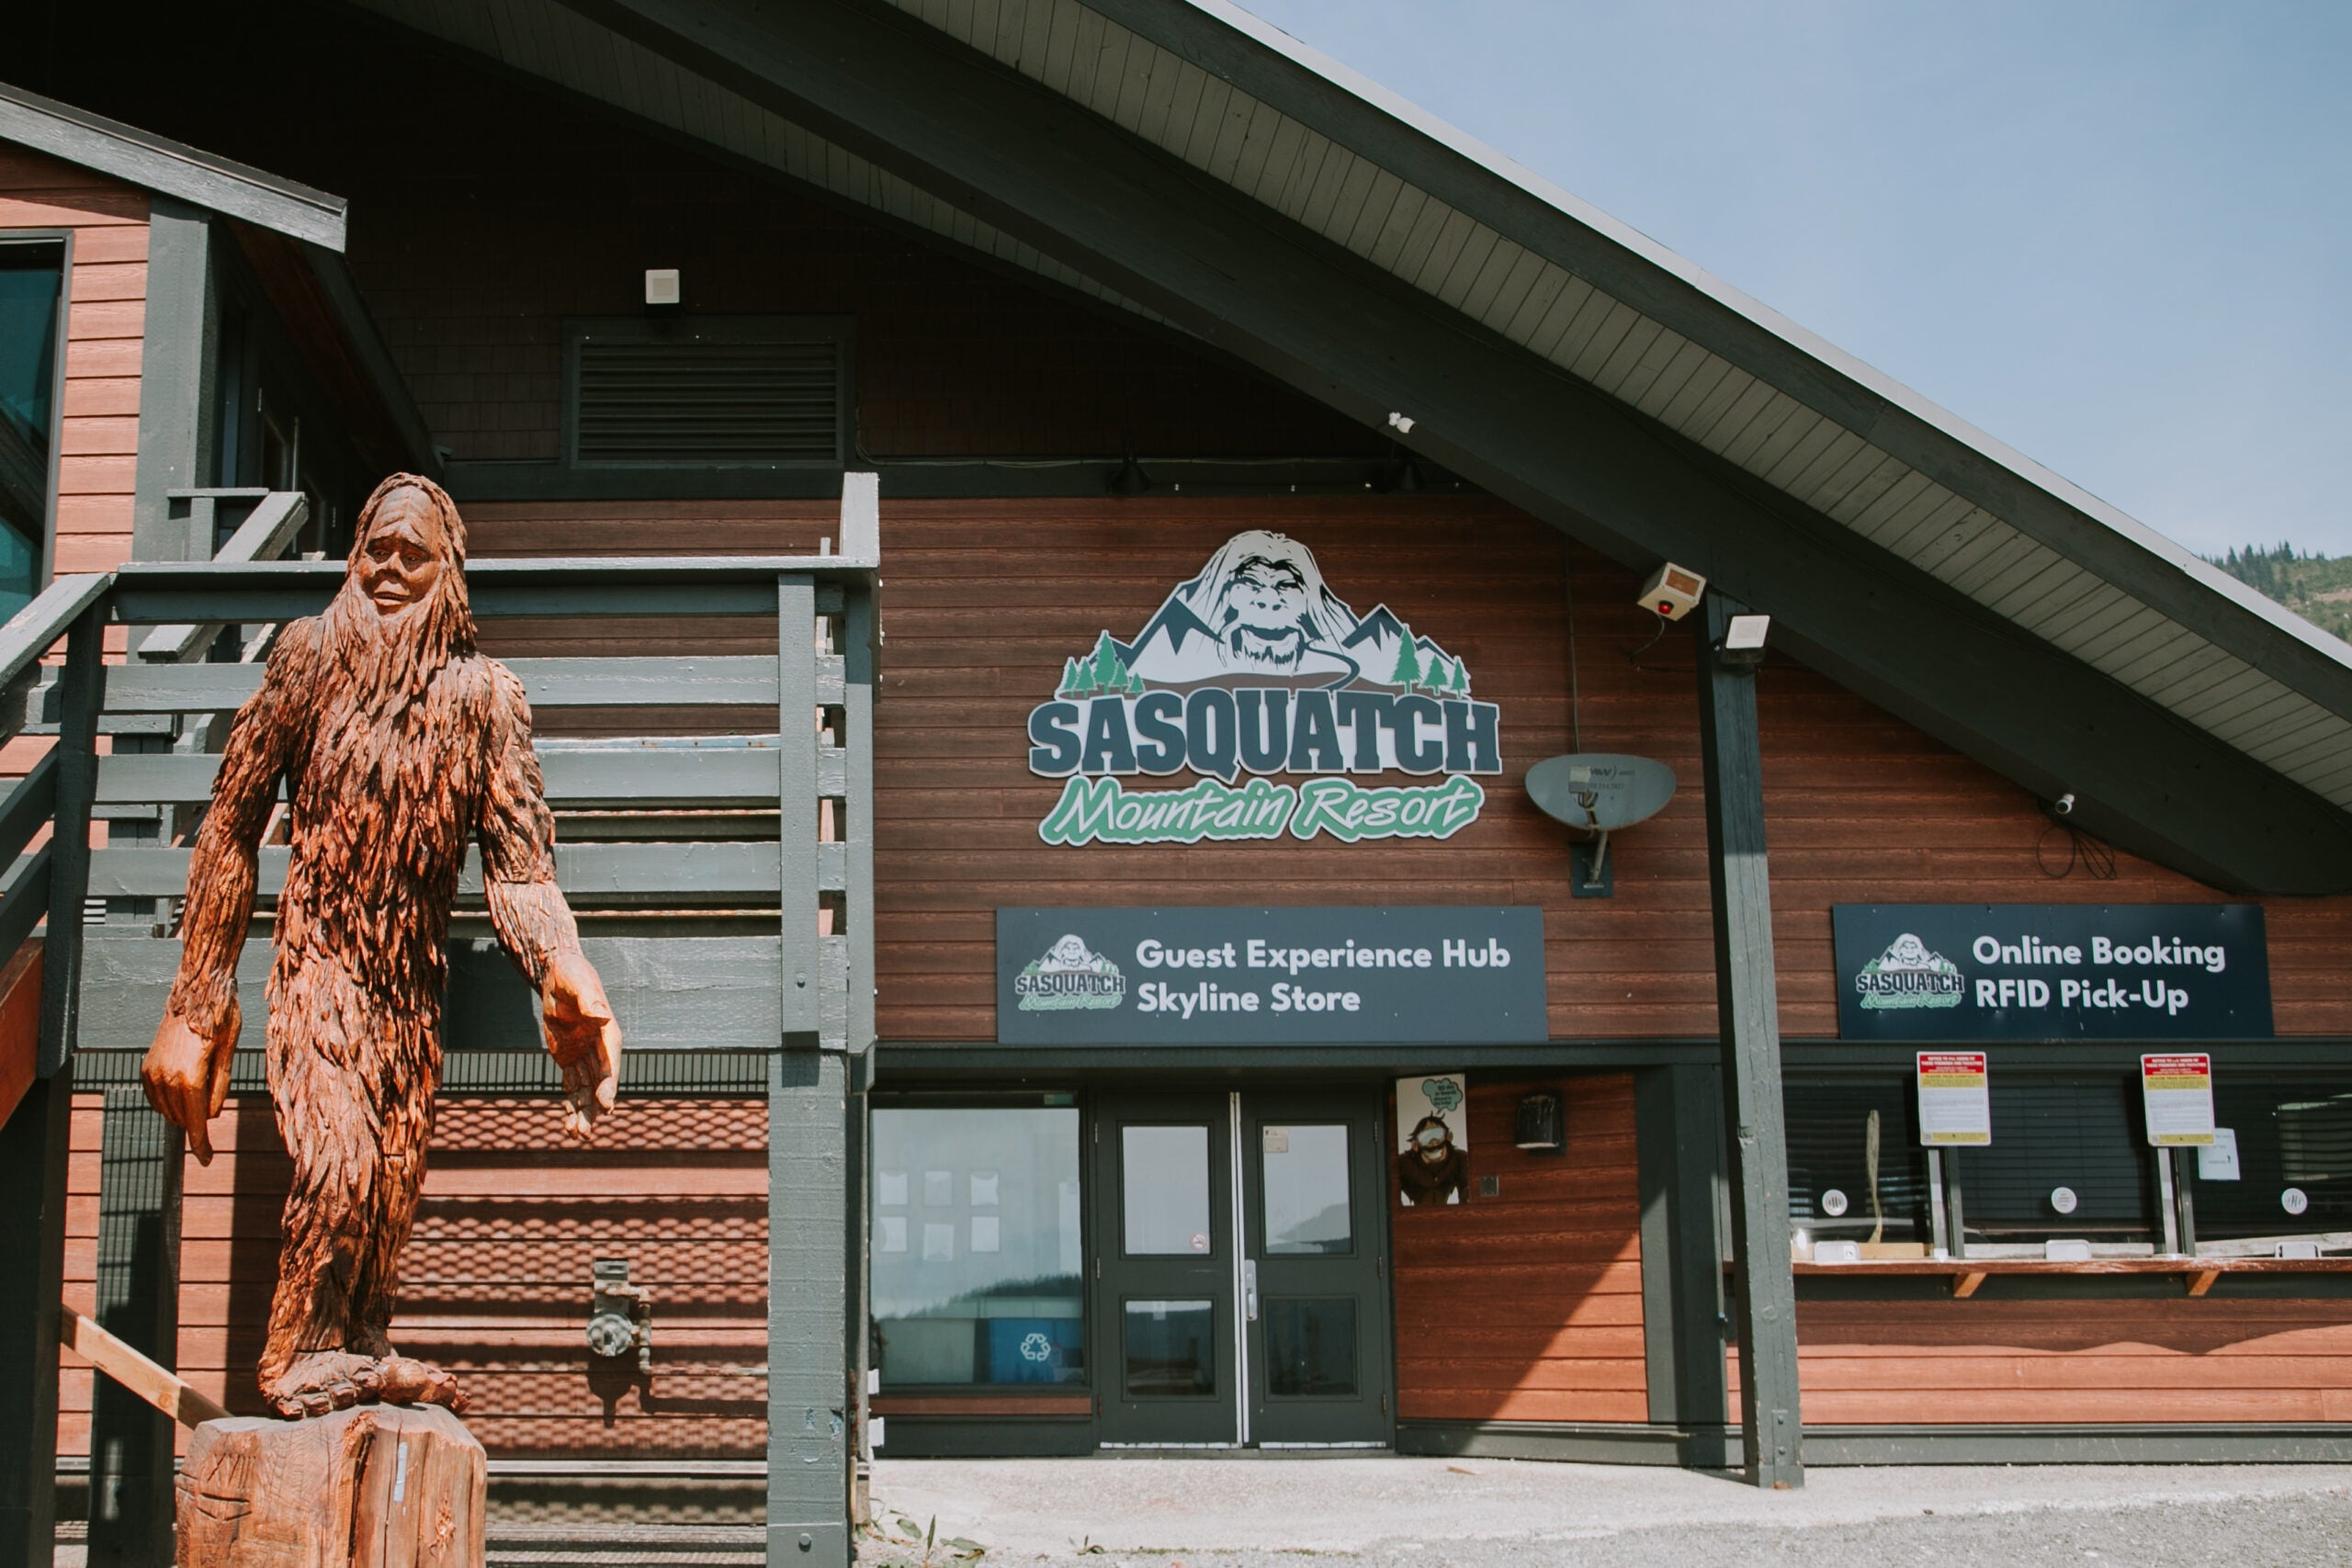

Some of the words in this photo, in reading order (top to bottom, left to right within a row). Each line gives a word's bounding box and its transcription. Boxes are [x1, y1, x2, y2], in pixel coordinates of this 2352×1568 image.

[1029, 687, 1502, 784] SASQUATCH
[1052, 784, 1288, 835] Mountain
[1302, 784, 1476, 830] Resort
[1136, 939, 1237, 968] Guest
[1247, 939, 1432, 976] Experience
[1442, 938, 1510, 968] Hub
[1973, 935, 2082, 964] Online
[2092, 935, 2225, 973] Booking
[1015, 975, 1125, 995] SASQUATCH
[1136, 982, 1260, 1020] Skyline
[1270, 982, 1361, 1011] Store
[1856, 973, 1964, 994] SASQUATCH
[1975, 979, 2050, 1008] RFID
[2061, 978, 2189, 1016] Pick-Up
